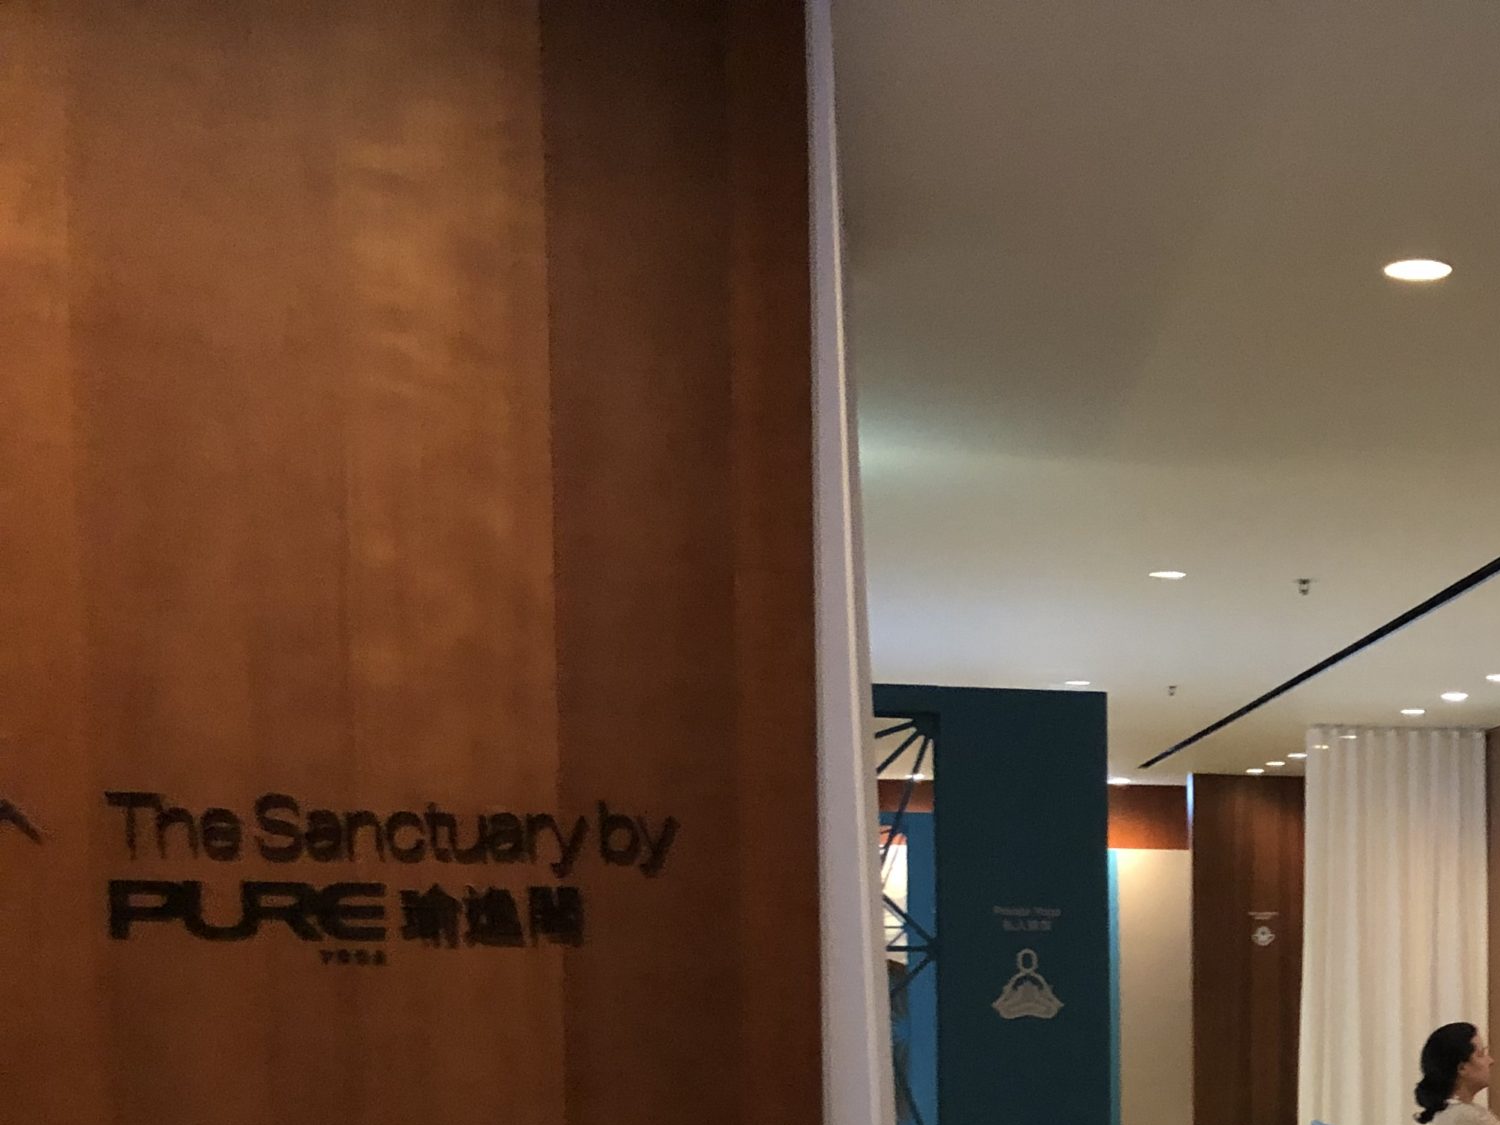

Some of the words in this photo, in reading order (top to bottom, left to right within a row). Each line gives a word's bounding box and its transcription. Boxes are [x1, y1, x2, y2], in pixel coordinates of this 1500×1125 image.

[105, 791, 243, 862] The
[254, 792, 589, 878] Sanctuary
[599, 800, 682, 878] by
[108, 879, 388, 942] PURE
